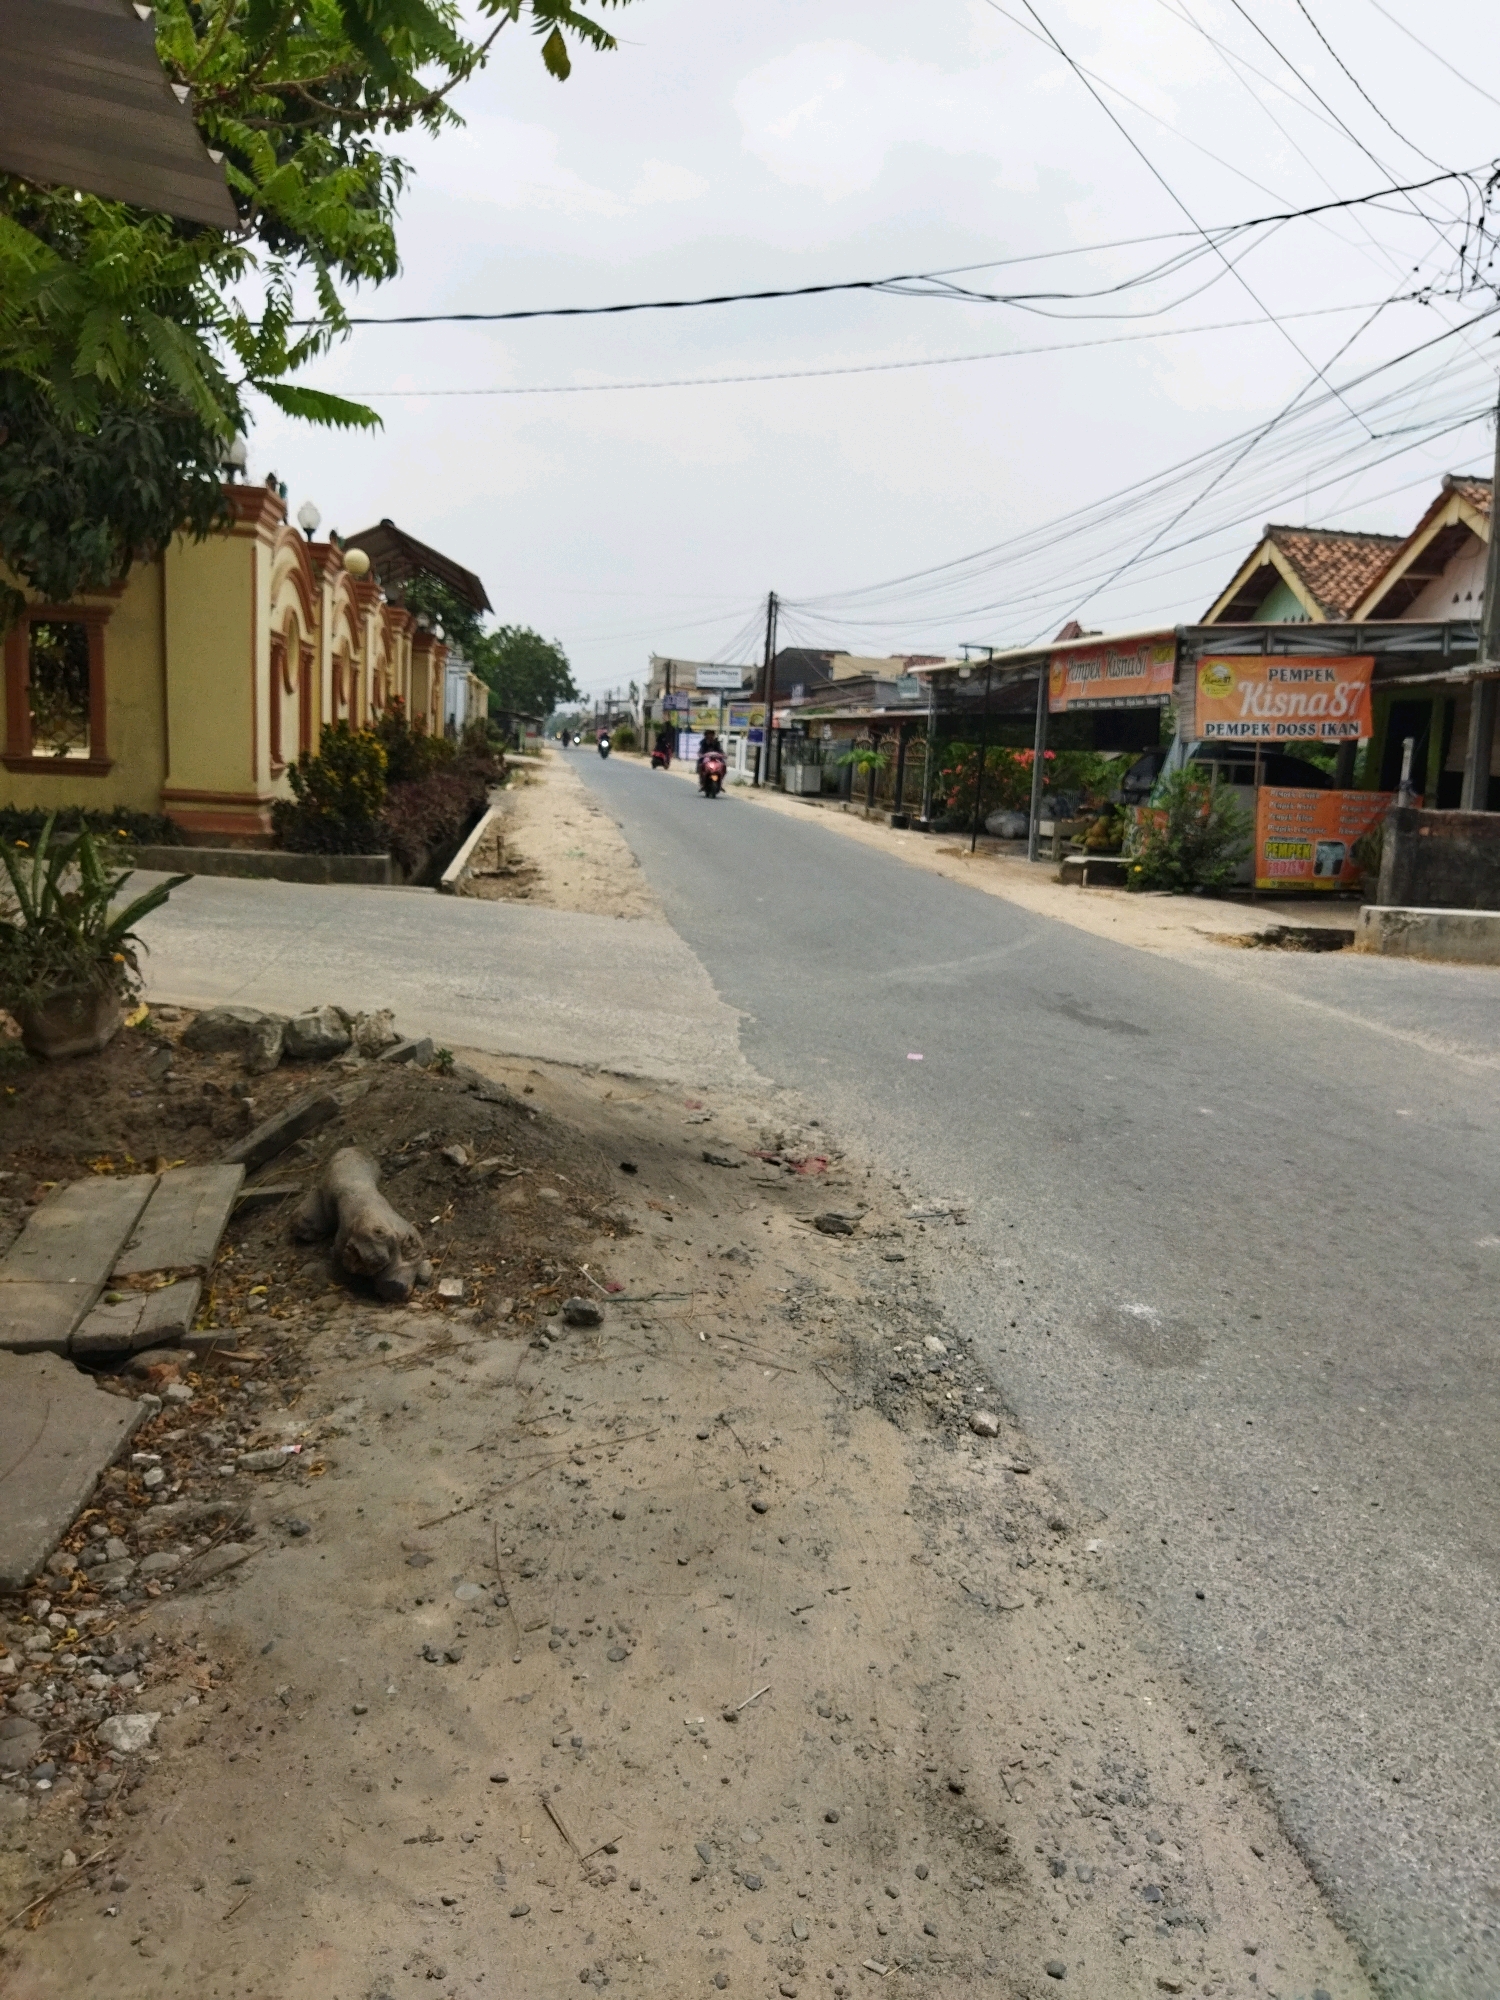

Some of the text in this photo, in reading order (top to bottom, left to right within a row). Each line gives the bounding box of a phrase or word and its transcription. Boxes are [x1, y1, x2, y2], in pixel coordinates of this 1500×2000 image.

[1067, 655, 1102, 695] Pempek
[1105, 645, 1149, 679] Kisna87
[1267, 668, 1336, 683] PEMPEK
[1238, 681, 1365, 718] Kisna87
[1204, 722, 1360, 737] PEMPEK DOSS IKAN
[1265, 842, 1312, 859] PEMPEK
